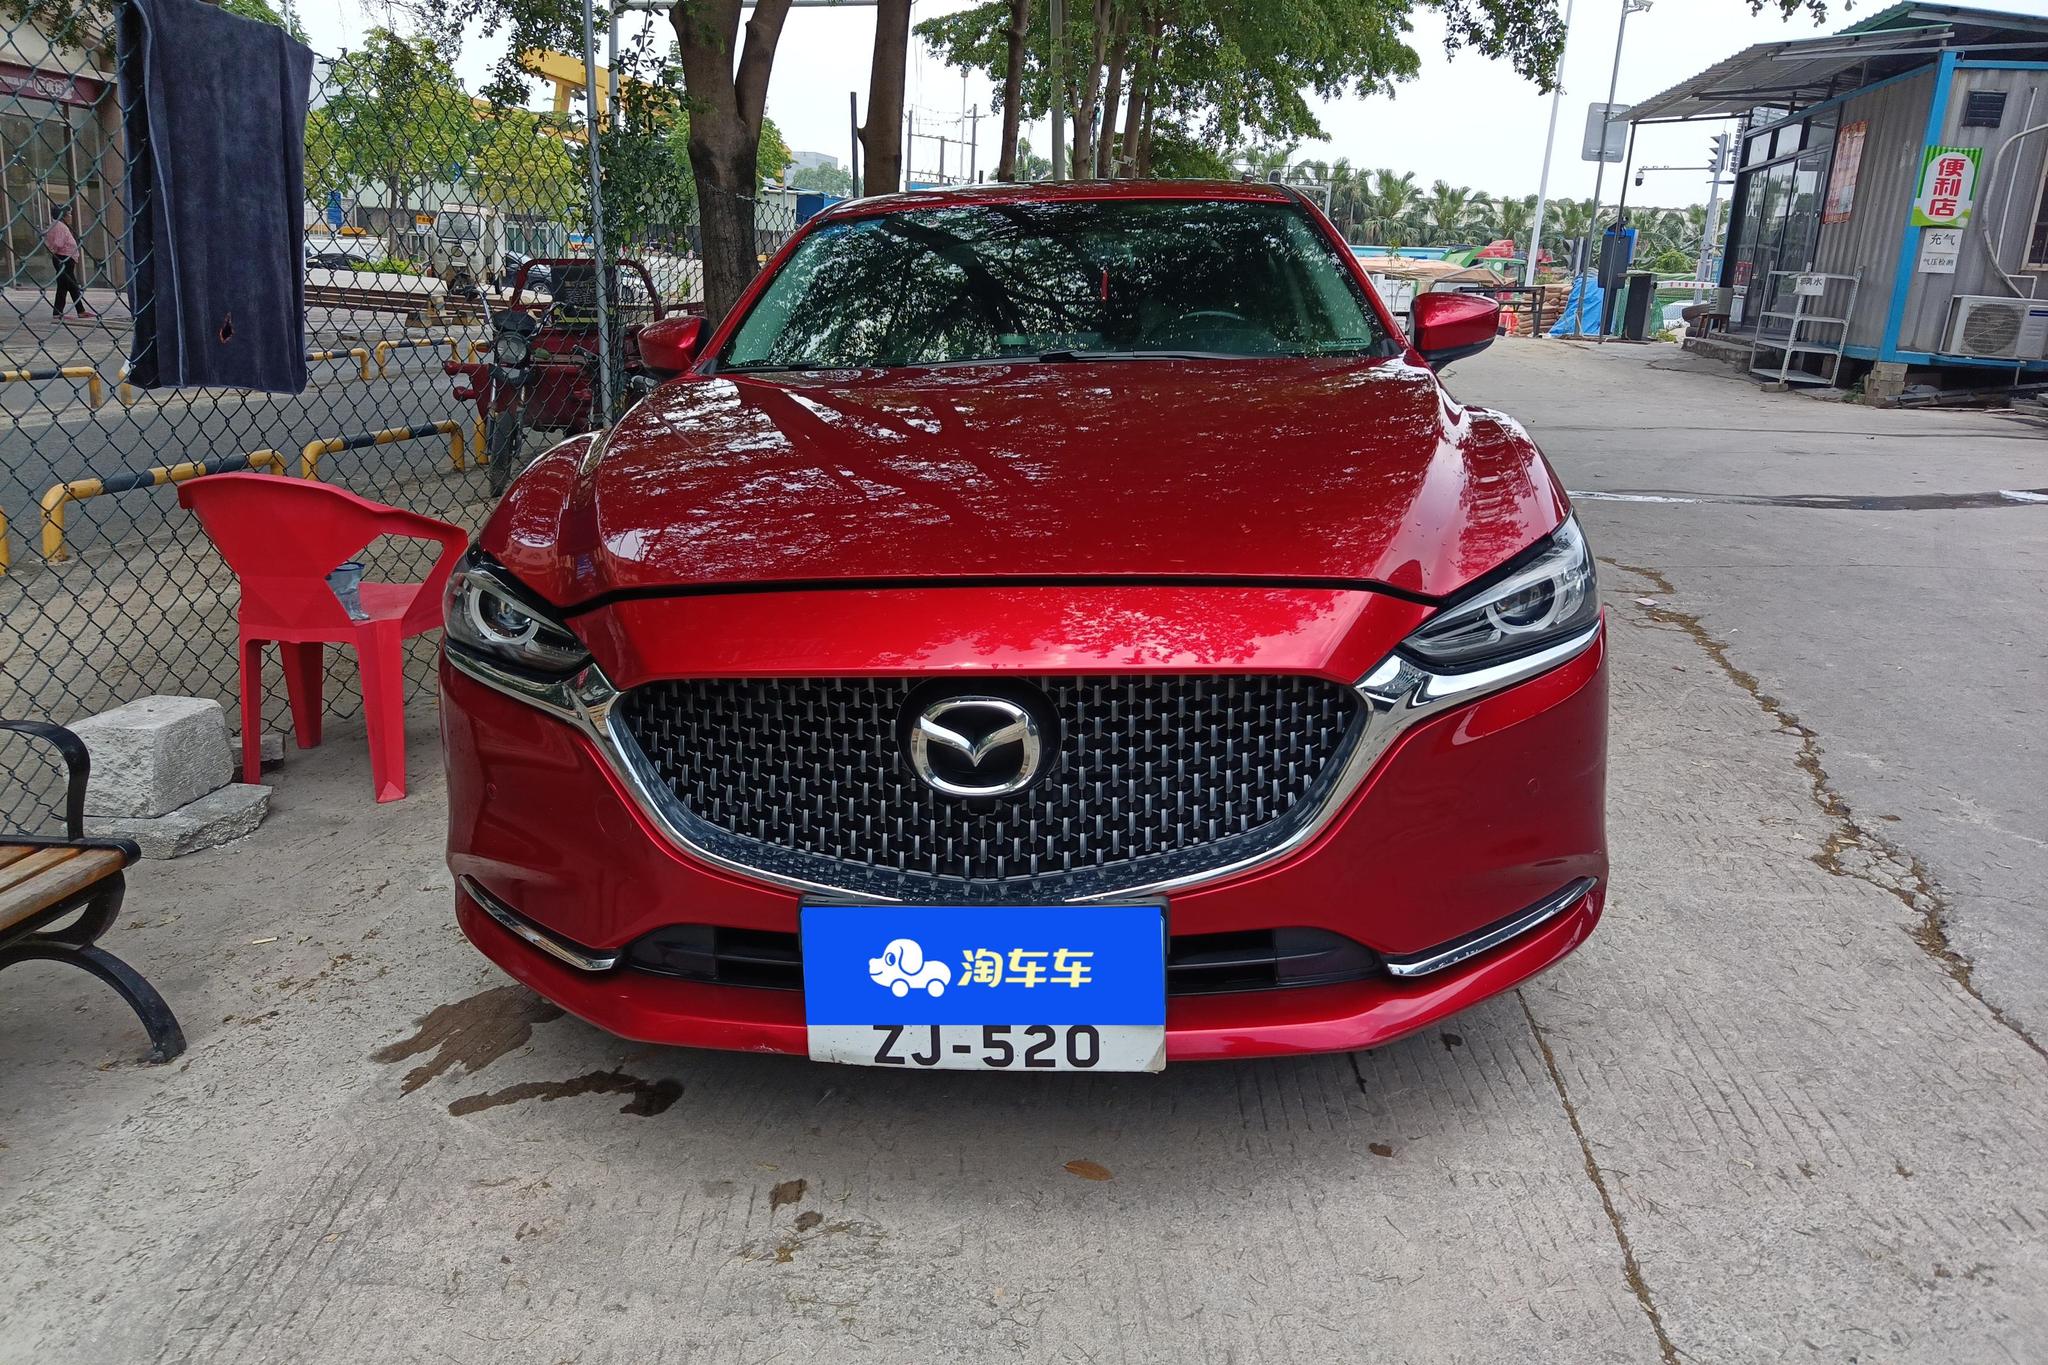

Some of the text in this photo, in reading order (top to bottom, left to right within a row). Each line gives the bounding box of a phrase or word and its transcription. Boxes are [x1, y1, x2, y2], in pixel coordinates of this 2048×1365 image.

[1928, 158, 1966, 216] 便利店
[1929, 233, 1955, 245] 充气
[872, 1025, 1100, 1068] ZJ-520
